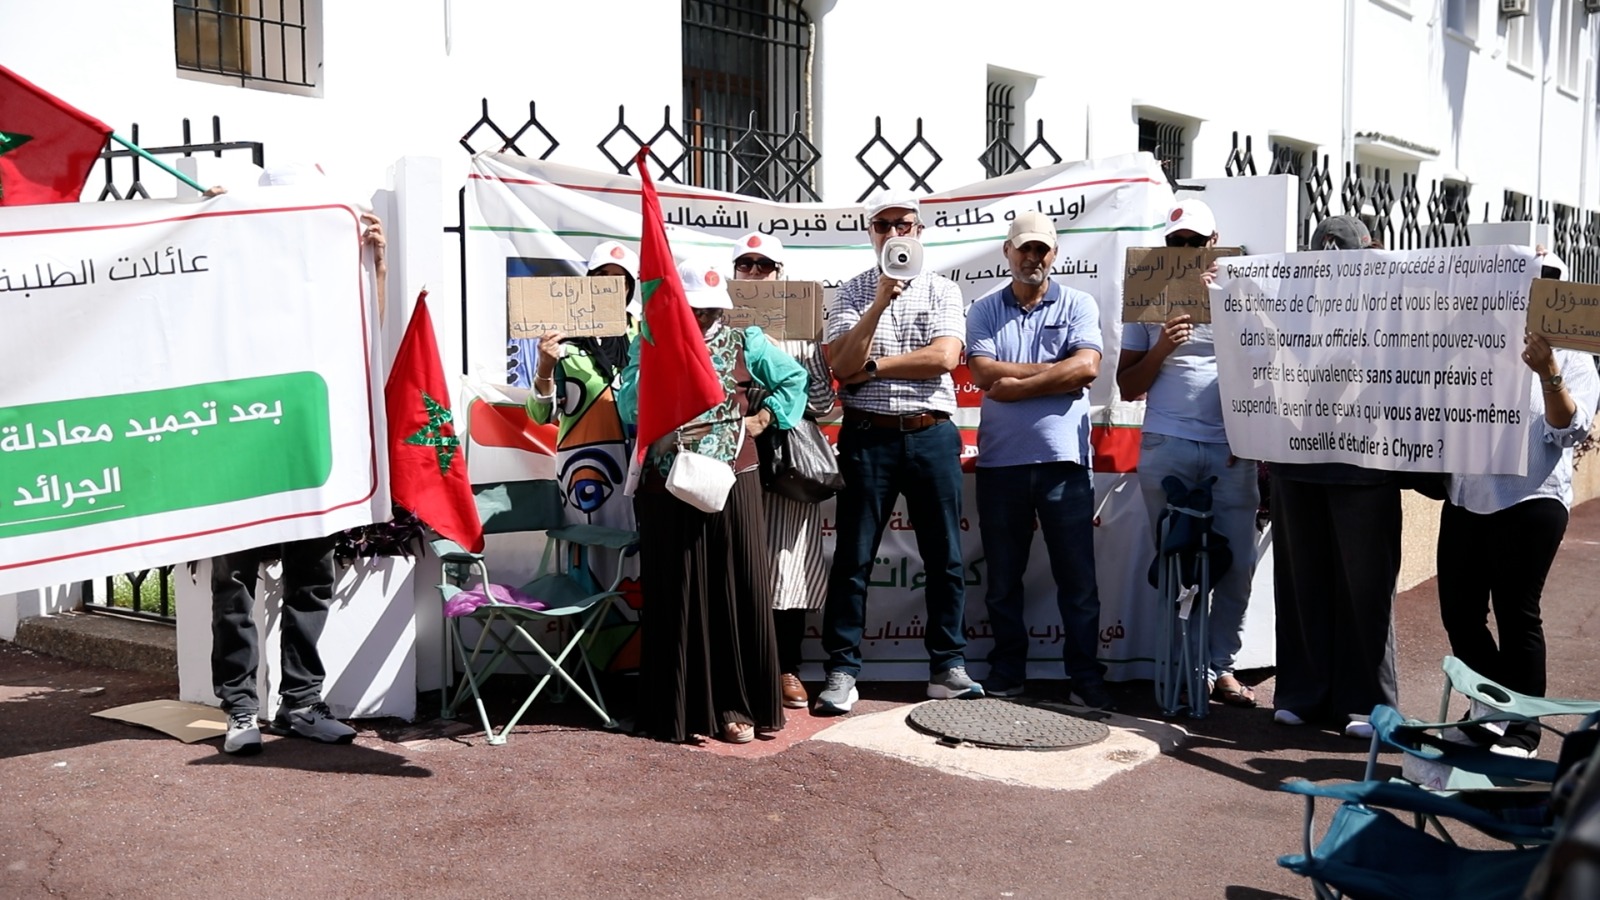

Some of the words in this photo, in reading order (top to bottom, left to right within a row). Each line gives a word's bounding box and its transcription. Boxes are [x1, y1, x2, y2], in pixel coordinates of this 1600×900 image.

[663, 205, 749, 231] الشمالي
[758, 213, 828, 238] قبرص
[935, 208, 995, 233] طلبة
[108, 246, 209, 281] عائلات
[1227, 262, 1269, 279] Pendant
[1271, 260, 1290, 279] des
[1293, 259, 1333, 281] années,
[1337, 262, 1362, 278] vous
[1363, 260, 1387, 276] avez
[1388, 256, 1435, 278] procédé
[1438, 255, 1445, 274] à
[1448, 253, 1527, 278] l'équivalence
[1224, 293, 1243, 313] des
[1245, 292, 1287, 316] diplômes
[1290, 293, 1304, 313] de
[1306, 294, 1342, 317] Chypre
[1345, 293, 1359, 312] du
[1361, 291, 1387, 311] Nord
[1390, 293, 1403, 311] et
[1405, 296, 1431, 311] vous
[1434, 291, 1449, 311] les
[1453, 295, 1478, 311] avez
[1545, 287, 1599, 313] مسؤول
[1240, 328, 1265, 347] dans
[1276, 328, 1322, 350] journaux
[1325, 327, 1370, 347] officiels.
[1374, 329, 1429, 348] Comment
[1432, 331, 1506, 352] pouvez-vous
[1282, 363, 1295, 382] les
[1297, 363, 1363, 387] équivalences
[1366, 369, 1392, 384] sans
[1395, 369, 1431, 385] aucun
[1434, 365, 1477, 389] préavis
[1480, 368, 1493, 386] et
[125, 400, 218, 443] تجميد
[228, 400, 283, 425] بعد
[1232, 396, 1277, 417] suspendre
[1315, 398, 1329, 417] de
[1332, 402, 1355, 417] ceux
[1364, 401, 1381, 423] qui
[1384, 405, 1411, 421] vous
[1414, 405, 1441, 422] avez
[1444, 403, 1521, 425] vous-mêmes
[0, 419, 114, 452] معادلة
[1289, 431, 1336, 451] conseillé
[1382, 436, 1389, 456] à
[1392, 438, 1434, 462] Chypre
[1437, 438, 1444, 459] ?
[13, 466, 122, 509] الجرائد
[1099, 619, 1126, 650] في
